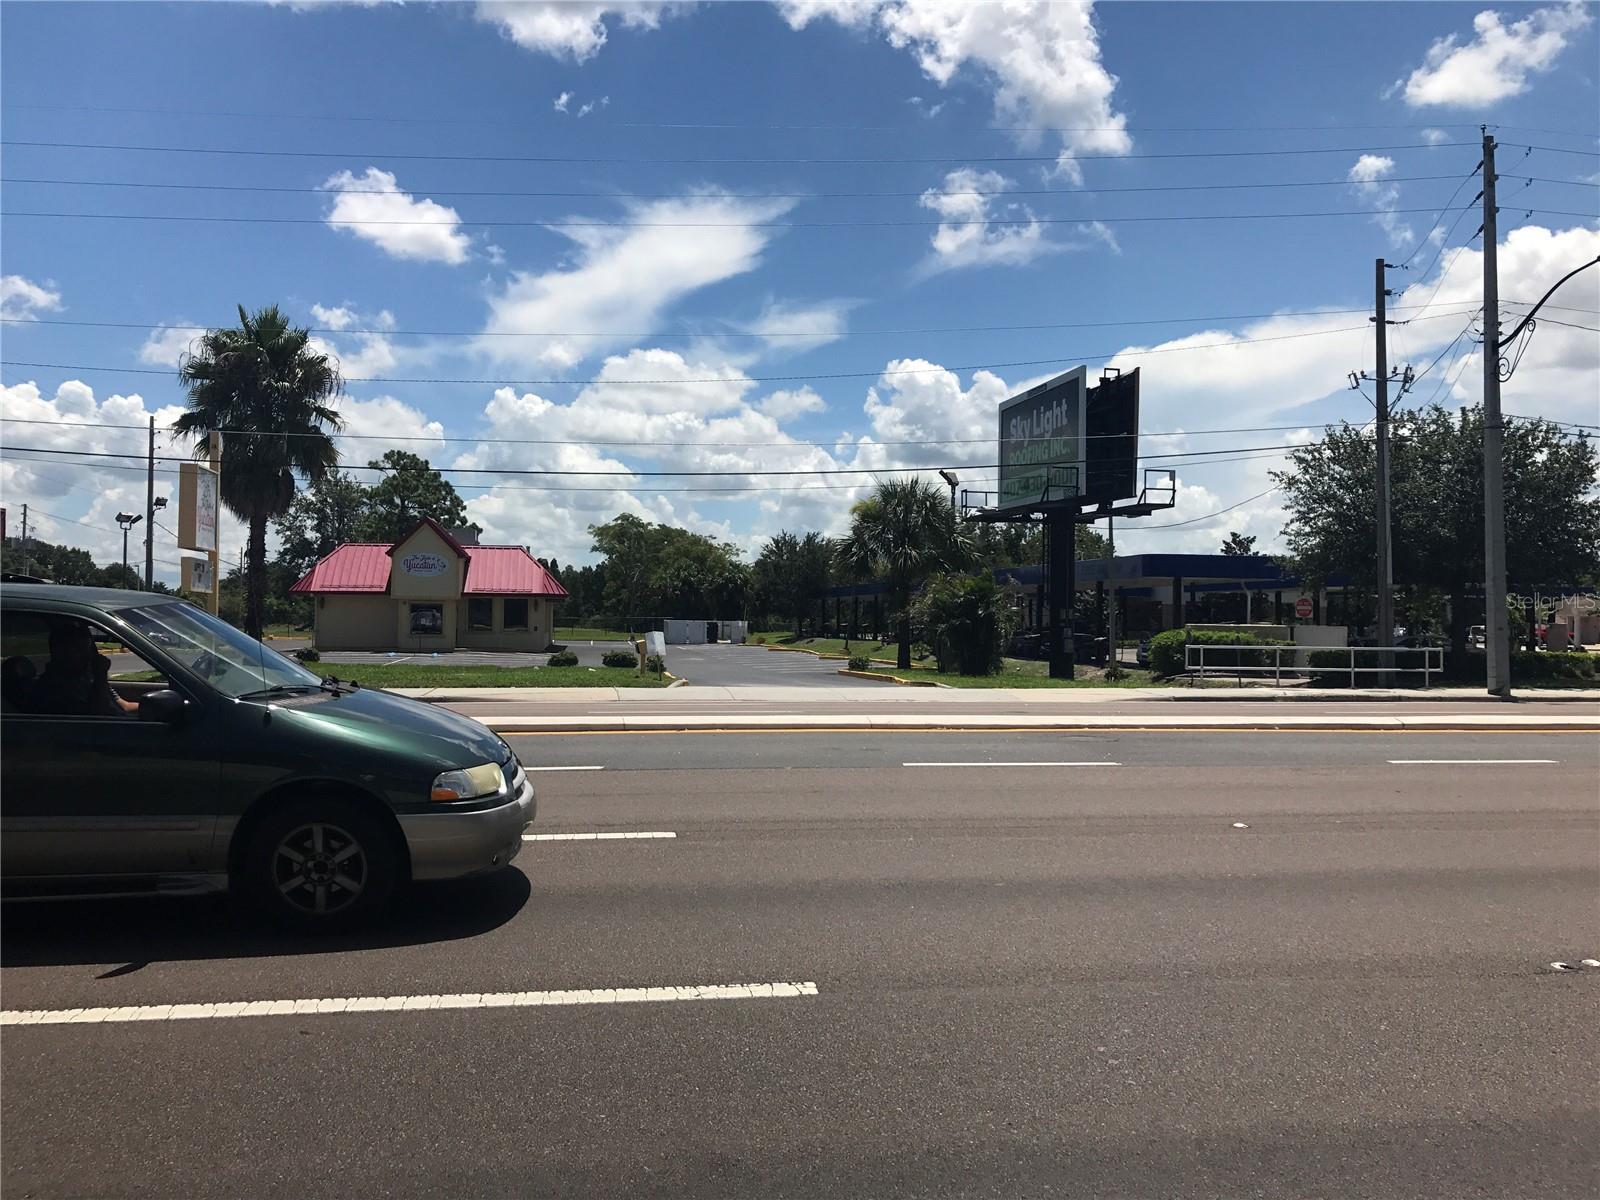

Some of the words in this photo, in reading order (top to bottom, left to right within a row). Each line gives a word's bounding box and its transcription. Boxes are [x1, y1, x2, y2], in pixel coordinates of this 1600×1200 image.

[1009, 416, 1031, 447] Sky
[1033, 398, 1068, 438] Light
[1009, 441, 1049, 471] ROOFING
[1050, 437, 1071, 458] INC.
[403, 559, 437, 573] Yucatan
